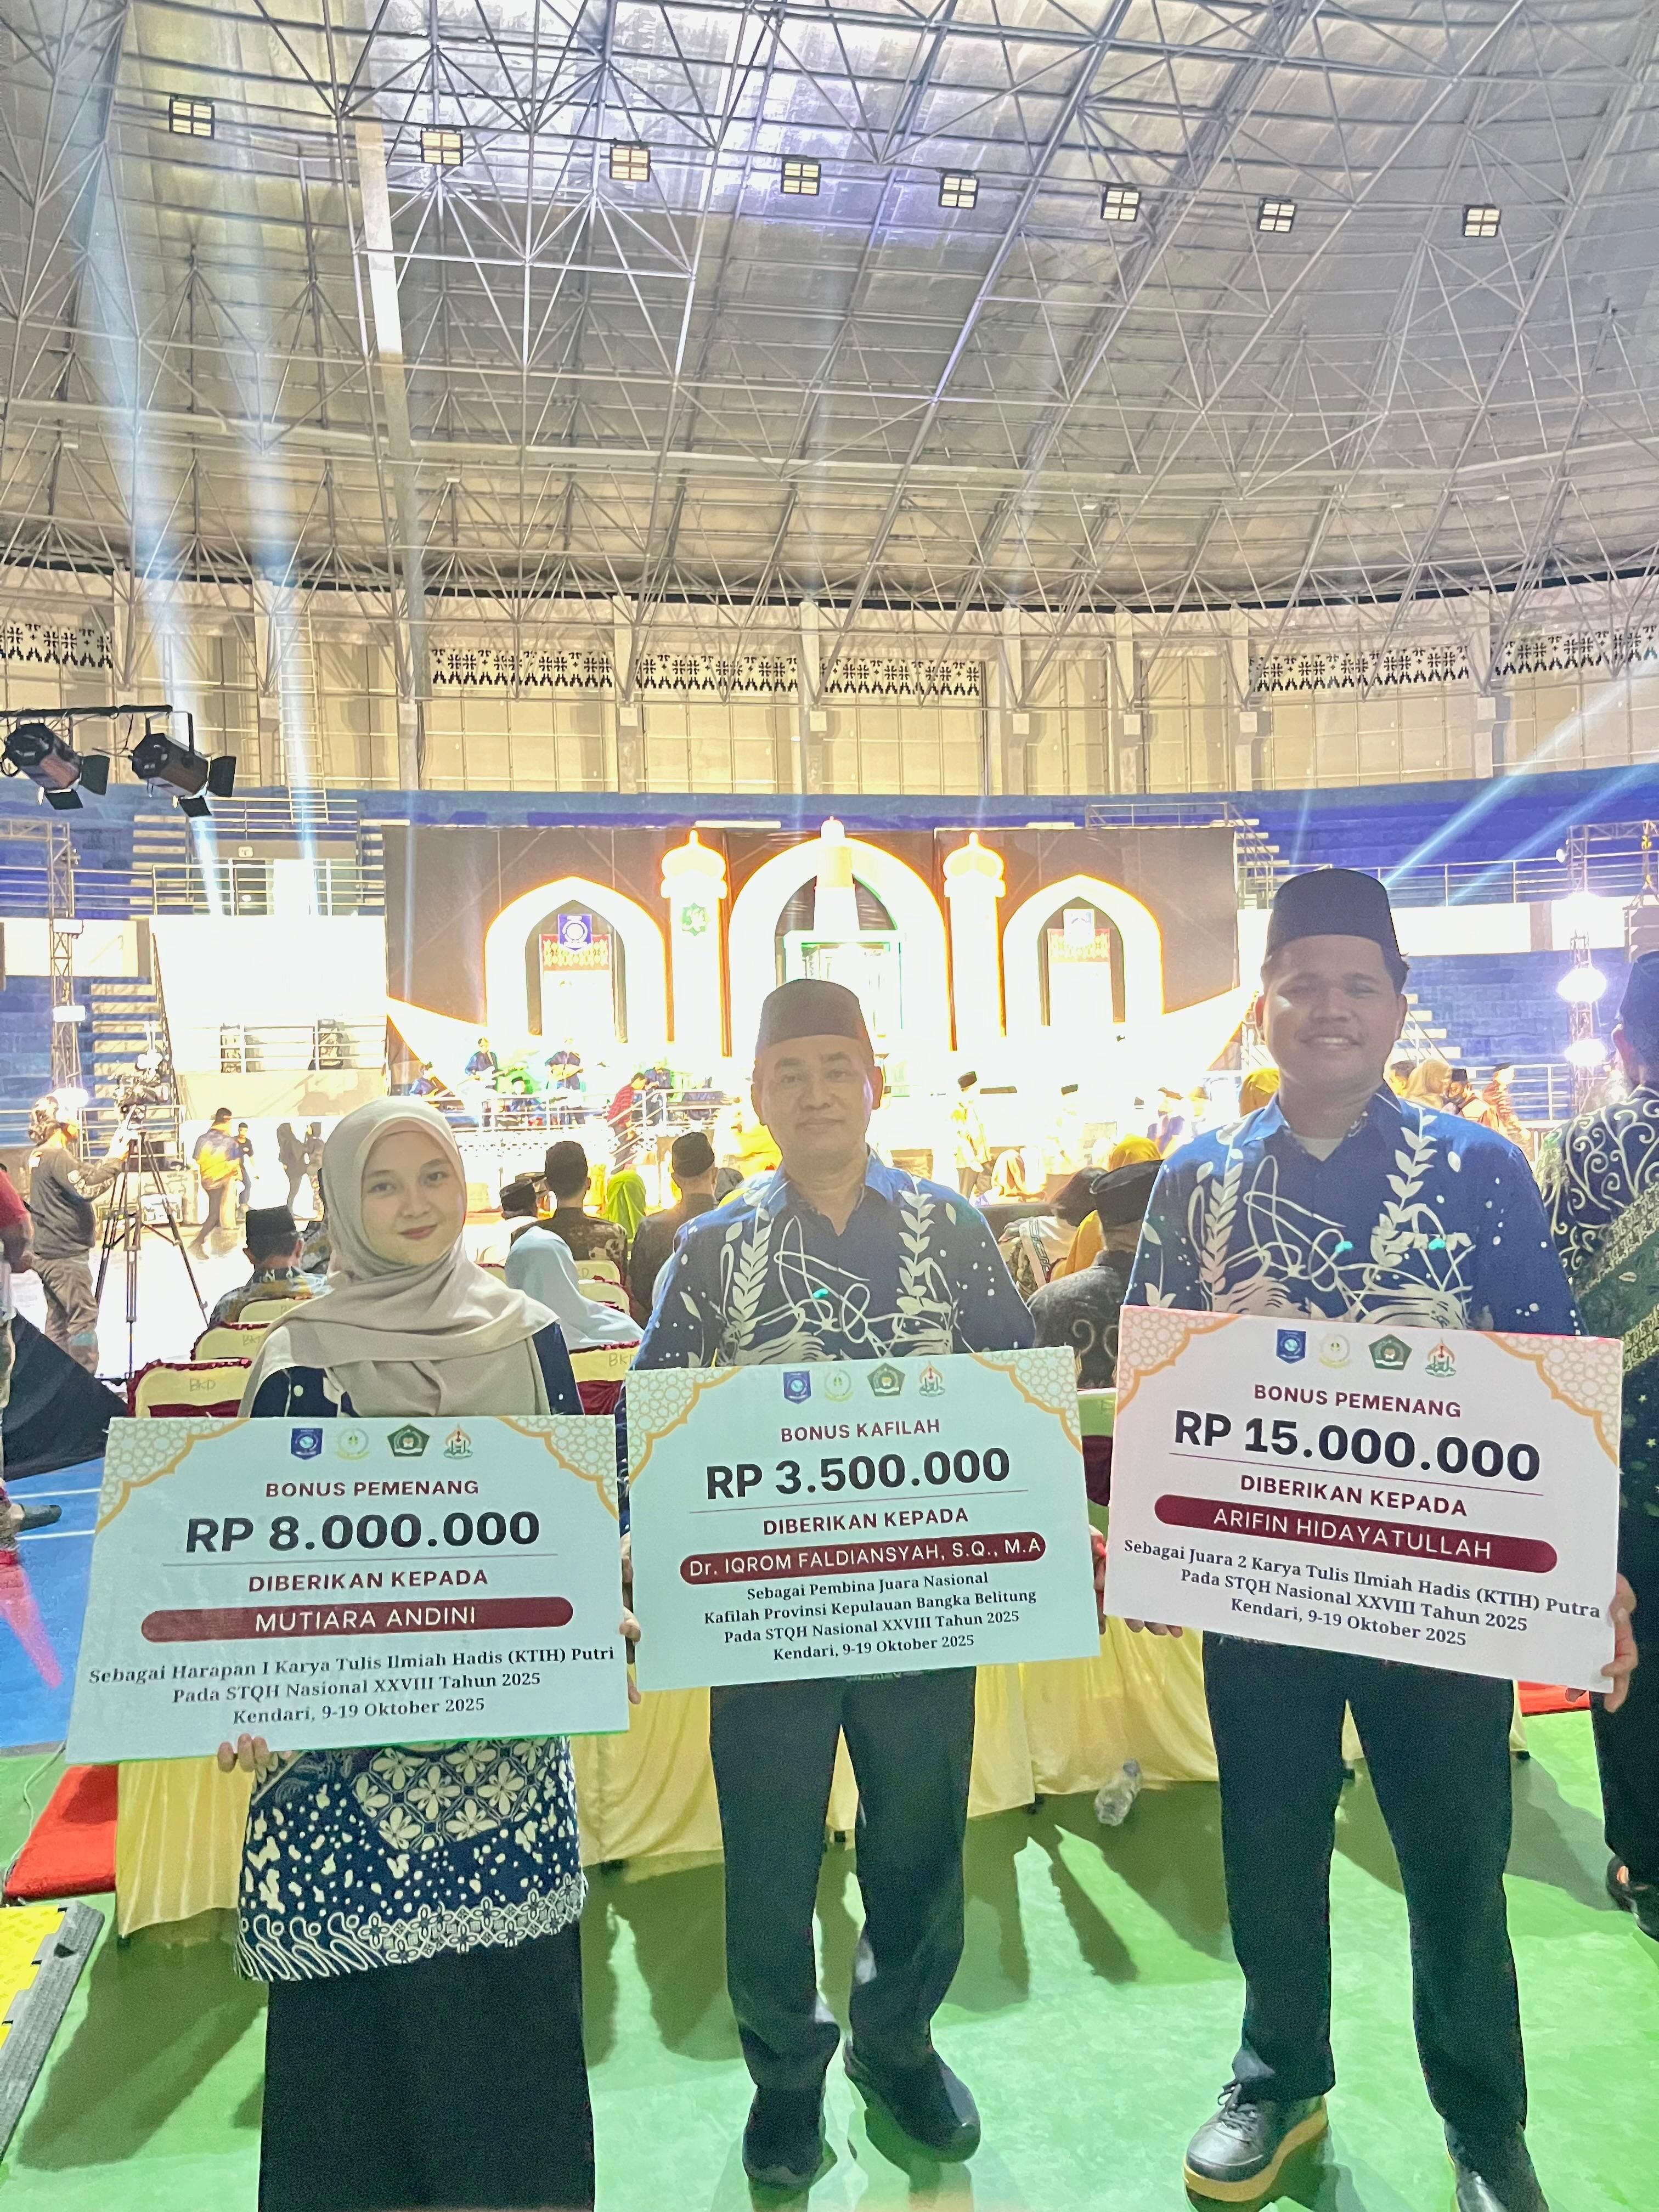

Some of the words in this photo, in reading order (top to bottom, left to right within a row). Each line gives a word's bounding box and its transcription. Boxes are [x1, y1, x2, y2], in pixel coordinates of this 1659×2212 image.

[189, 1378, 216, 1392] BKD
[1254, 1384, 1328, 1406] BONUS
[1335, 1391, 1460, 1418] PEMENANG
[781, 1424, 850, 1442] BONUS
[856, 1419, 940, 1438] KAFILAH
[1175, 1410, 1231, 1447] RP
[1245, 1418, 1540, 1481] 15.000.000
[266, 1482, 346, 1498] BONUS
[354, 1480, 478, 1497] PEMENANG
[707, 1463, 763, 1500] RP
[776, 1447, 1009, 1494] 3.500.000
[1241, 1475, 1362, 1504] DIBERIKAN
[1370, 1489, 1467, 1517] KEPADA
[186, 1517, 254, 1553] RP
[269, 1511, 539, 1551] 8.000.000
[764, 1513, 877, 1536] DIBERIKAN
[884, 1507, 968, 1527] KEPADA
[1214, 1509, 1287, 1533] ARIFIN
[1297, 1519, 1490, 1559] HIDAYATULLAH
[690, 1561, 717, 1576] Dr.
[725, 1554, 791, 1573] IQROM
[799, 1544, 945, 1568] FALDIANSYAH,
[952, 1541, 997, 1558] S.Q.,
[1005, 1538, 1041, 1554] M.A
[249, 1572, 382, 1593] DIBERIKAN
[392, 1569, 488, 1588] KEPADA
[747, 1584, 805, 1601] Sebagai
[809, 1581, 874, 1595] Pembina
[879, 1579, 919, 1594] Juara
[924, 1571, 988, 1588] Nasional
[1124, 1539, 1185, 1561] Sebagai
[1188, 1548, 1233, 1566] Juara
[1238, 1555, 1246, 1568] 2
[1251, 1557, 1301, 1578] Karya
[1306, 1565, 1348, 1582] Tulis
[1354, 1571, 1413, 1592] Ilmiah
[1418, 1579, 1470, 1600] Hadis
[1476, 1588, 1539, 1611] (KTIH)
[1546, 1598, 1600, 1618] Putra
[705, 1609, 760, 1624] Kafilah
[764, 1604, 826, 1620] Provinsi
[831, 1600, 912, 1617] Kepulauan
[916, 1594, 970, 1610] Bangka
[975, 1591, 1036, 1604] Belitung
[1181, 1568, 1220, 1586] Pada
[1225, 1575, 1271, 1595] STQH
[1276, 1582, 1351, 1605] Nasional
[1356, 1594, 1415, 1615] XXVIII
[1420, 1603, 1480, 1624] Tahun
[1485, 1613, 1527, 1631] 2025
[256, 1610, 376, 1632] MUTIARA
[386, 1606, 475, 1627] ANDINI
[724, 1629, 761, 1644] Pada
[765, 1626, 808, 1642] STQH
[812, 1620, 878, 1637] Nasional
[883, 1616, 931, 1631] XXVIII
[935, 1614, 983, 1628] Tahun
[987, 1610, 1019, 1624] 2025
[1231, 1598, 1302, 1623] Kendari,
[1308, 1610, 1342, 1626] 9-19
[1347, 1616, 1421, 1639] Oktober
[1426, 1627, 1466, 1646] 2025
[774, 1644, 838, 1661] Kendari,
[843, 1642, 872, 1655] 9-19
[876, 1638, 938, 1652] Oktober
[942, 1634, 974, 1647] 2025
[91, 1666, 165, 1684] Sebagai
[173, 1665, 255, 1680] Harapan
[263, 1662, 268, 1674] I
[276, 1661, 330, 1676] Karya
[336, 1656, 381, 1670] Tulis
[388, 1654, 446, 1668] Ilmiah
[453, 1651, 503, 1666] Hadis
[508, 1648, 566, 1664] (KTIH)
[572, 1646, 614, 1661] Putri
[174, 1688, 219, 1703] Pada
[227, 1685, 279, 1703] STQH
[287, 1680, 367, 1696] Nasional
[374, 1677, 433, 1692] XXVIII
[439, 1674, 496, 1689] Tahun
[502, 1672, 540, 1686] 2025
[234, 1708, 315, 1724] Kendari,
[322, 1705, 358, 1718] 9-19
[364, 1701, 439, 1716] Oktober
[445, 1697, 484, 1712] 2025
